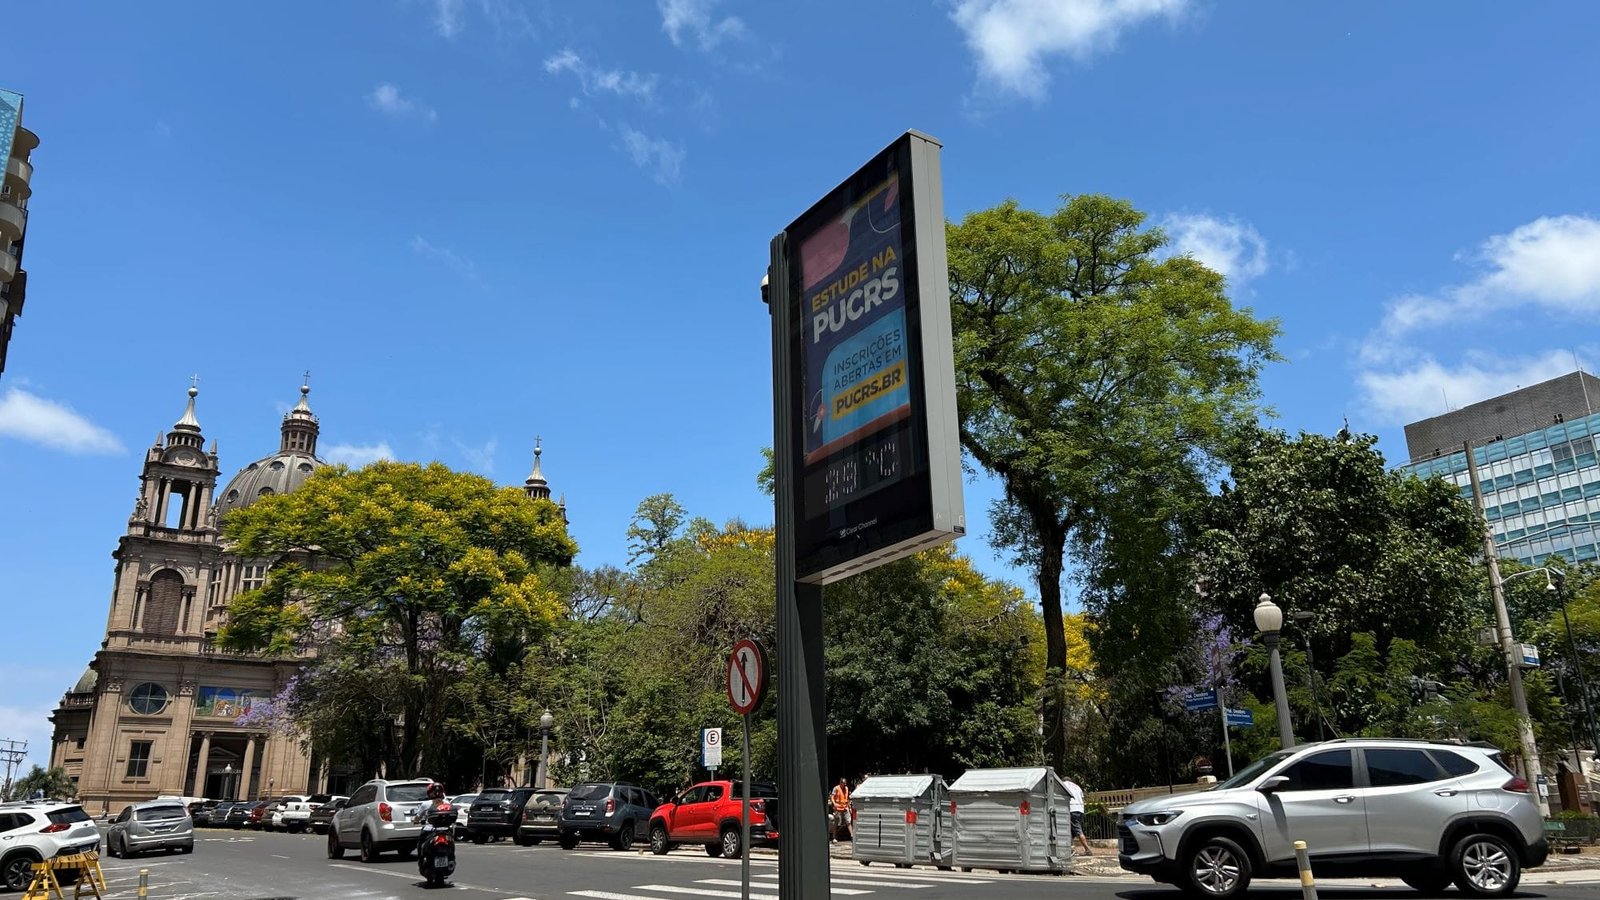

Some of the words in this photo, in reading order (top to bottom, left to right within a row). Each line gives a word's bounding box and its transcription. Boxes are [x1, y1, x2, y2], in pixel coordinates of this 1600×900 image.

[812, 262, 869, 311] ESTUDE
[872, 245, 897, 273] NA
[813, 266, 899, 343] PUCRS
[833, 329, 902, 375] INSCRIÇÕES
[833, 356, 882, 391] ABERTAS
[883, 346, 901, 365] EM
[836, 368, 901, 414] PUCRS.BR
[710, 733, 715, 742] E
